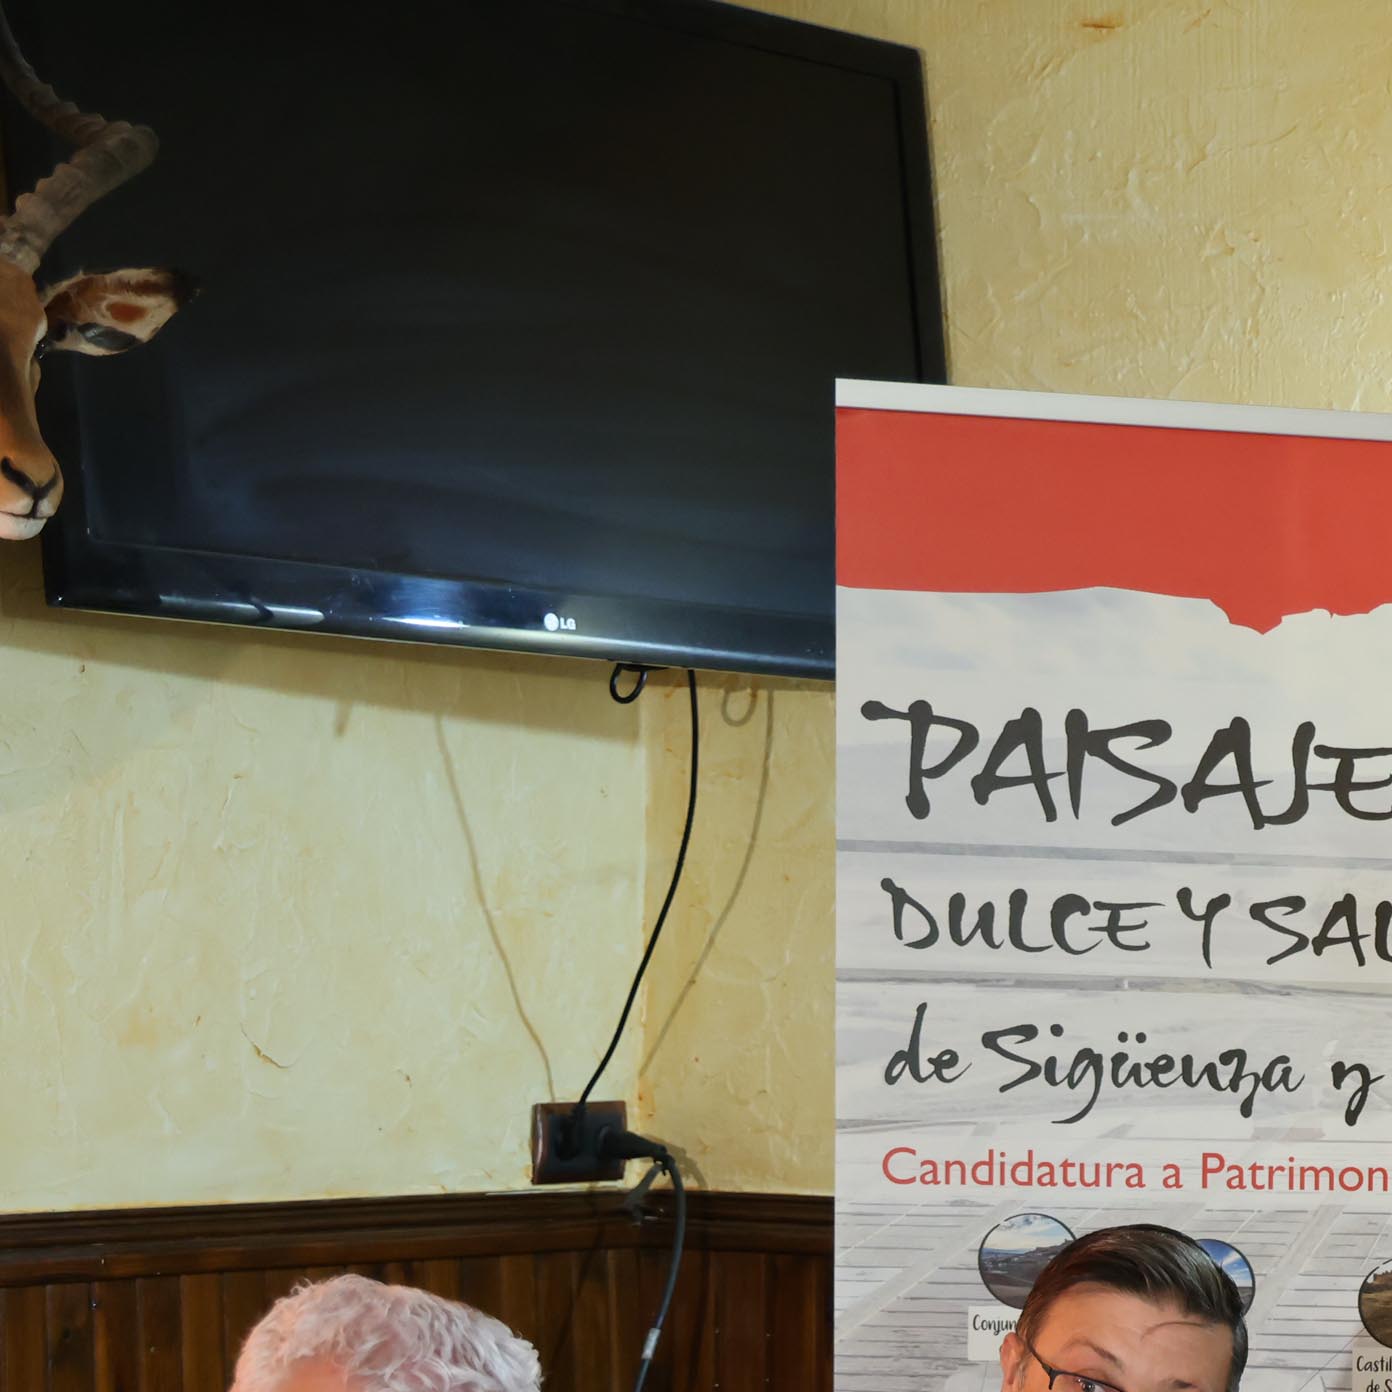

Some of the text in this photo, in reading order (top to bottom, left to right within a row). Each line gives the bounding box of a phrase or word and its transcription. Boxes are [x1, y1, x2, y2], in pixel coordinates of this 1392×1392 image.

[560, 617, 577, 630] LG
[880, 876, 1163, 956] DULCE
[1176, 886, 1233, 968] Y
[884, 1002, 971, 1087] de
[982, 1023, 1305, 1125] Sigüenza
[1331, 1058, 1384, 1126] y
[881, 1147, 1146, 1190] Candidatura
[1162, 1164, 1184, 1190] a
